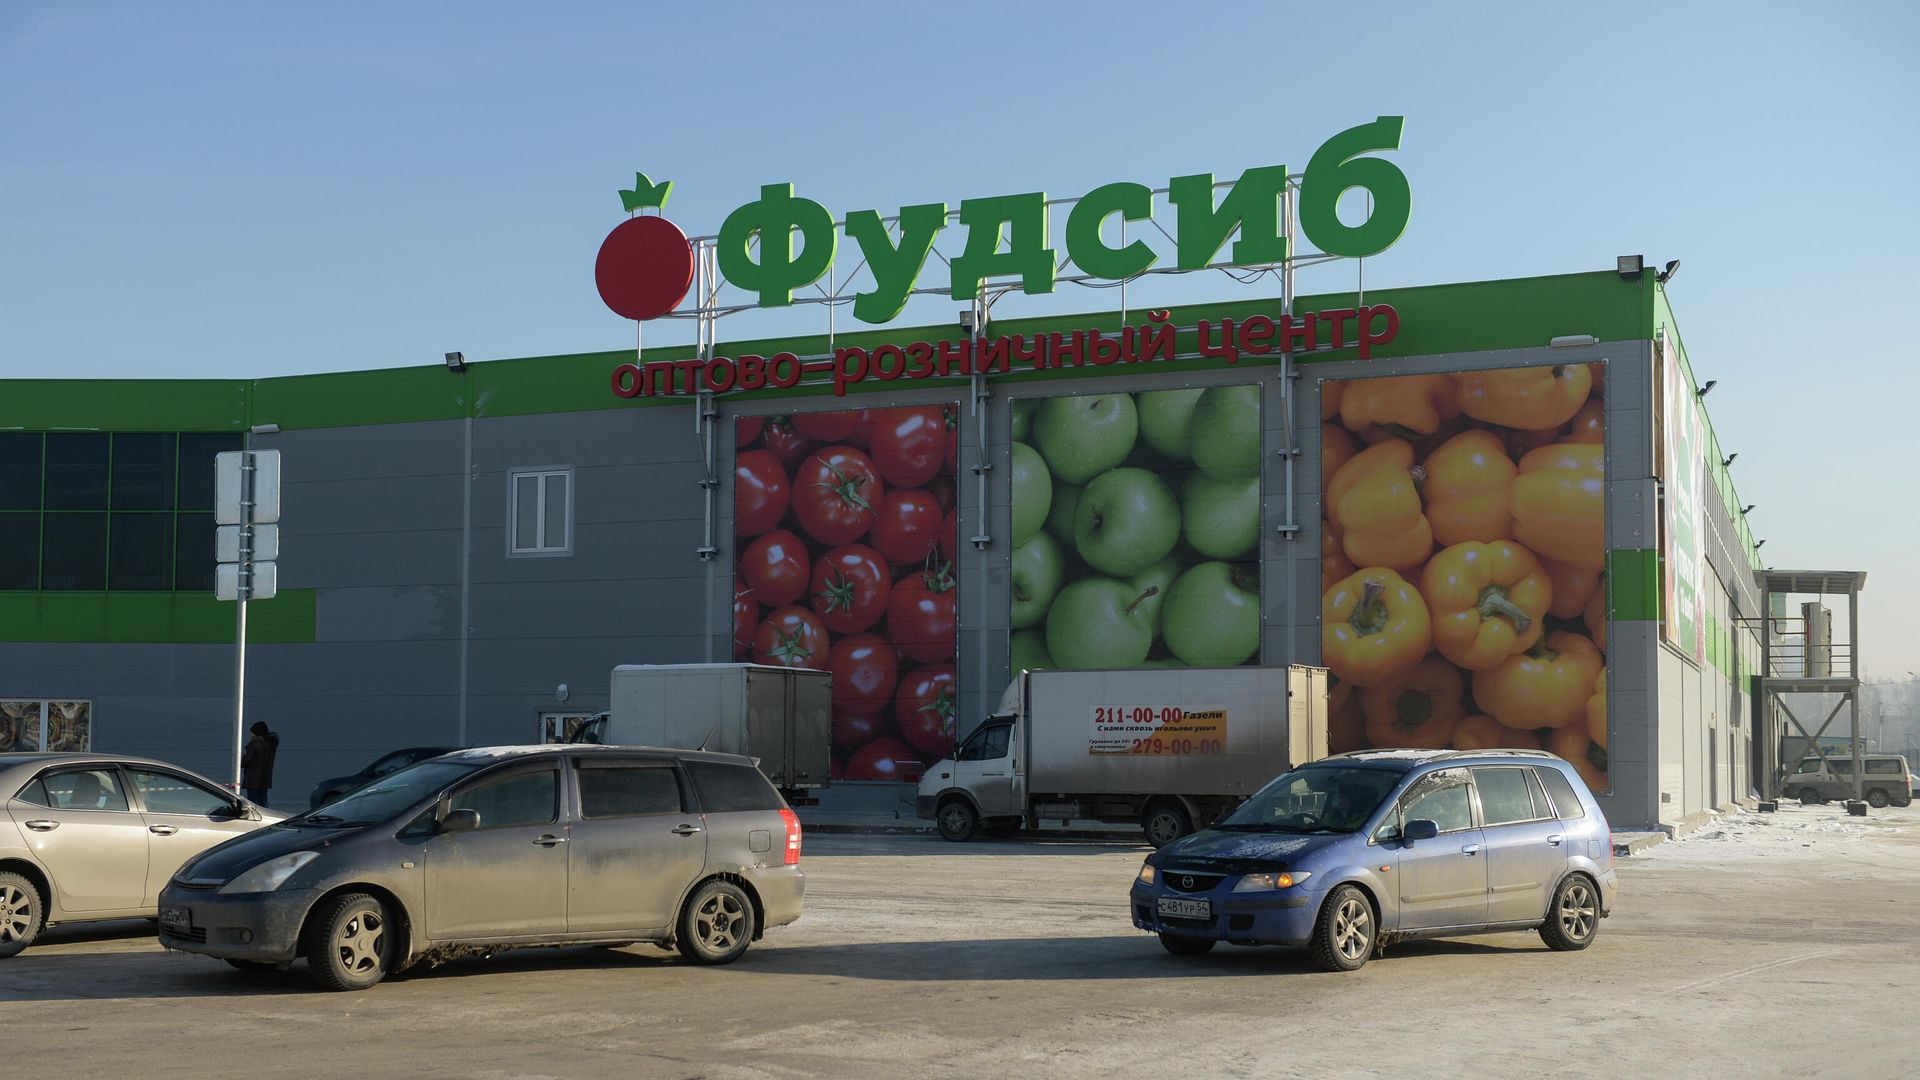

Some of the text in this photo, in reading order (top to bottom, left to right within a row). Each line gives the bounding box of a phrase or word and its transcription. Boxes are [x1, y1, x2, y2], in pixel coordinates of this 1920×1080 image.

[716, 115, 1412, 324] Фудсиб
[611, 302, 1400, 398] оптово-розничный центр
[1095, 707, 1182, 723] 211-00-00
[1183, 711, 1223, 720] Газели
[1154, 725, 1194, 733] игольное
[1194, 725, 1217, 733] ушко
[1132, 738, 1221, 754] 279-00-00
